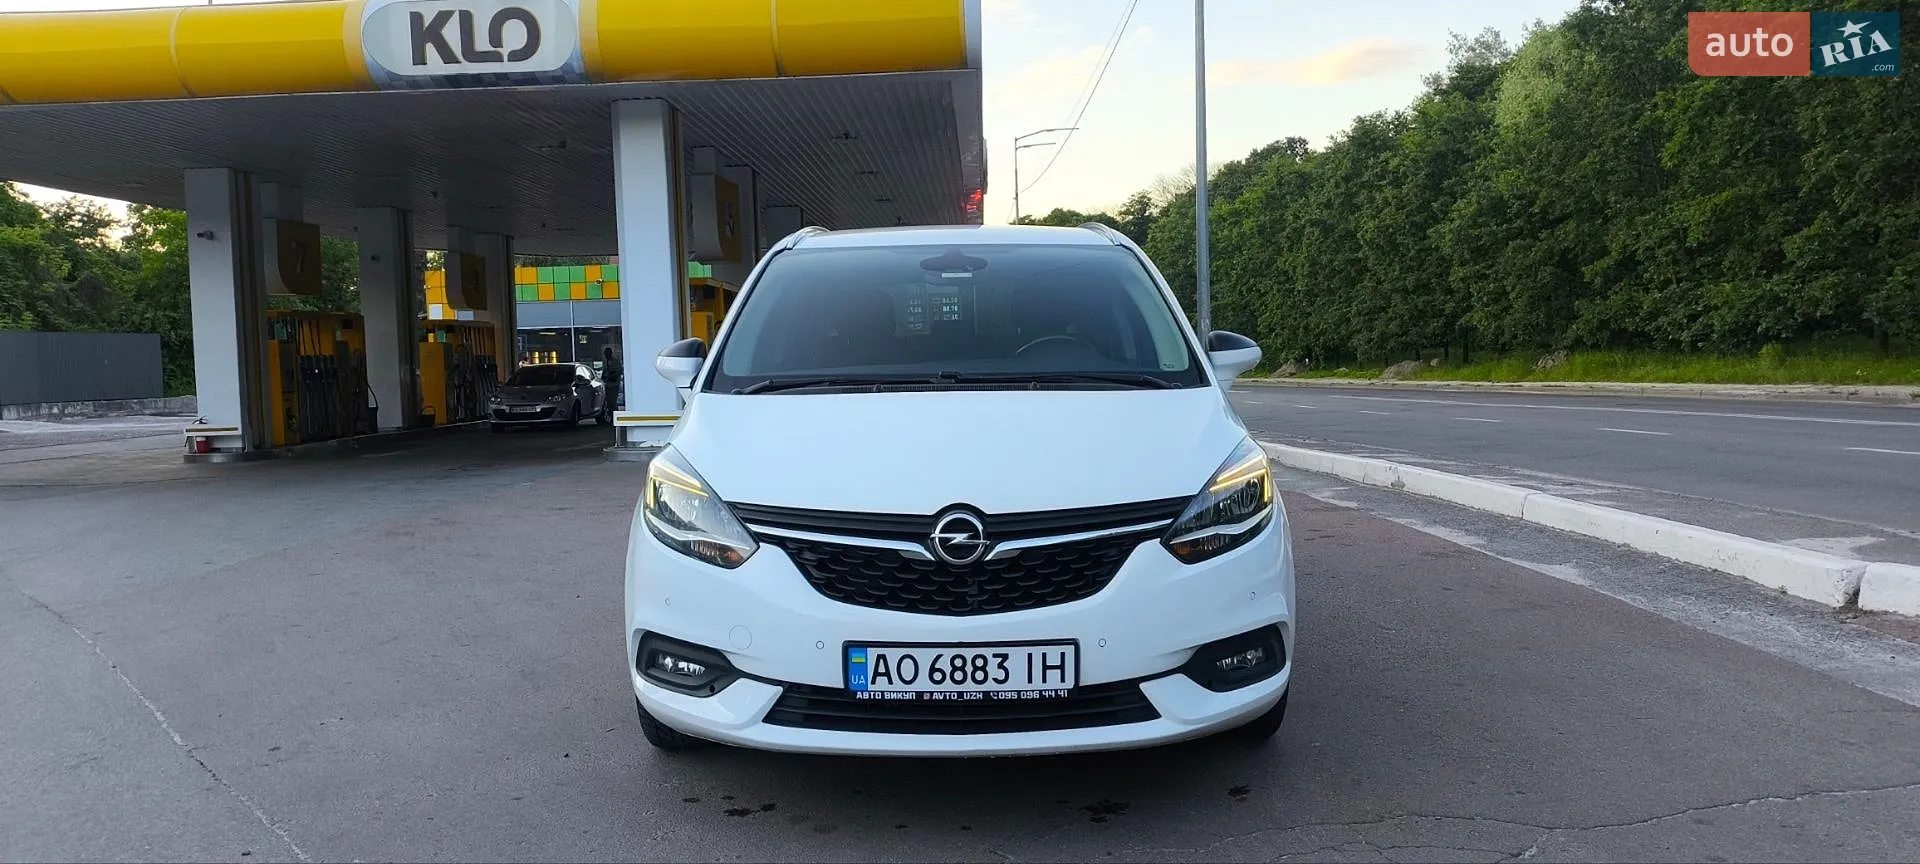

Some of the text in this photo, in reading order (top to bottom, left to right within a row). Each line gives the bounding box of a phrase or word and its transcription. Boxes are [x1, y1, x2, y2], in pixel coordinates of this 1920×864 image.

[408, 6, 541, 66] KLO
[870, 651, 1066, 686] AO 6883 IH
[851, 675, 866, 685] UA
[856, 691, 882, 699] АВТО
[998, 691, 1018, 700] 095
[1020, 691, 1040, 700] 096
[1042, 690, 1056, 699] 44
[1057, 690, 1068, 698] 41
